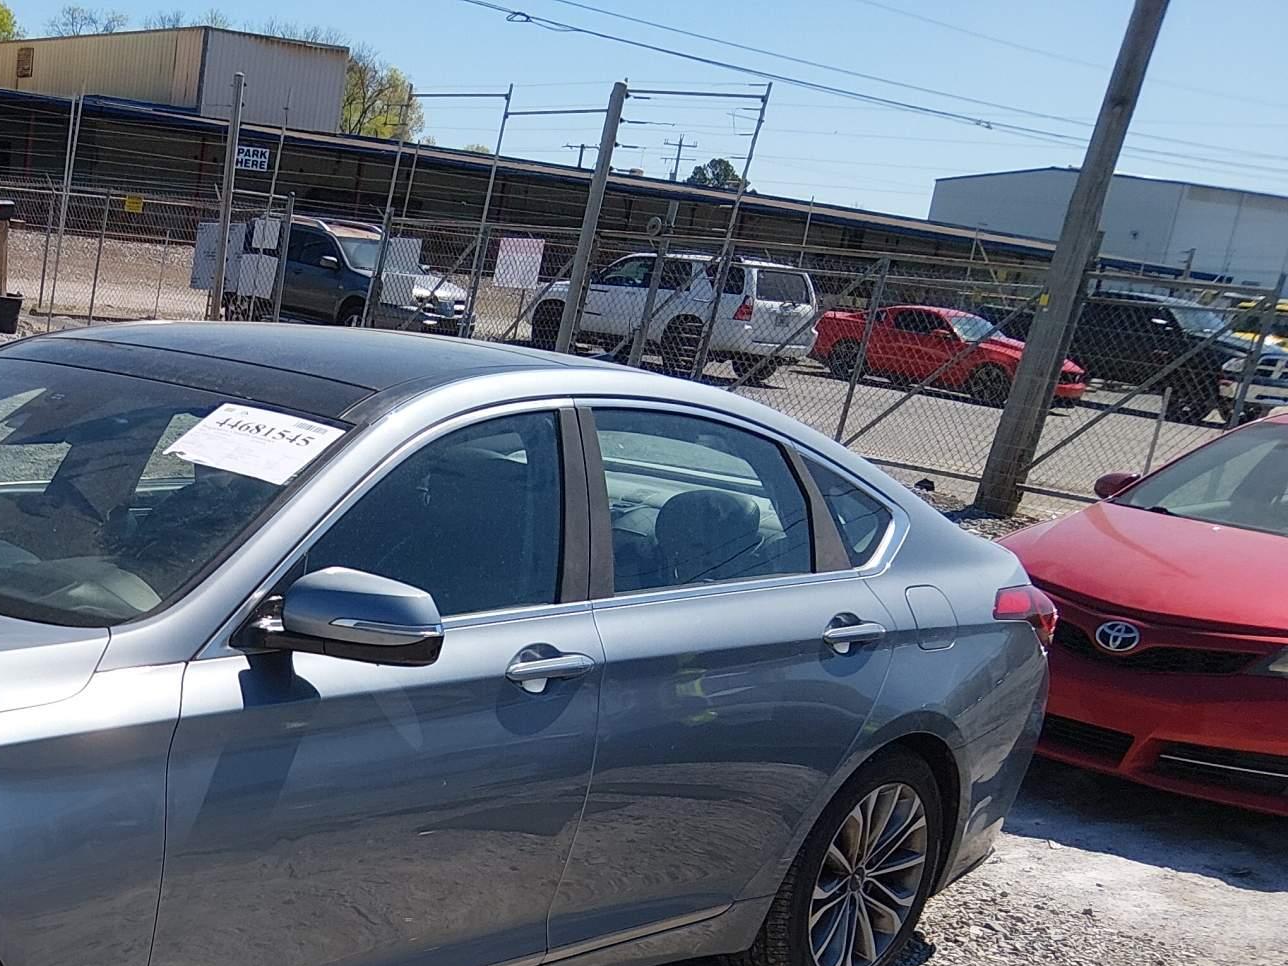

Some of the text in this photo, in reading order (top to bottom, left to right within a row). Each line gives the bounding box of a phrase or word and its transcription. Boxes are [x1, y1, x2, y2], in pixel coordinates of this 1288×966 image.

[237, 147, 268, 160] PARK
[235, 158, 267, 169] HERE
[215, 416, 316, 447] 44681545
